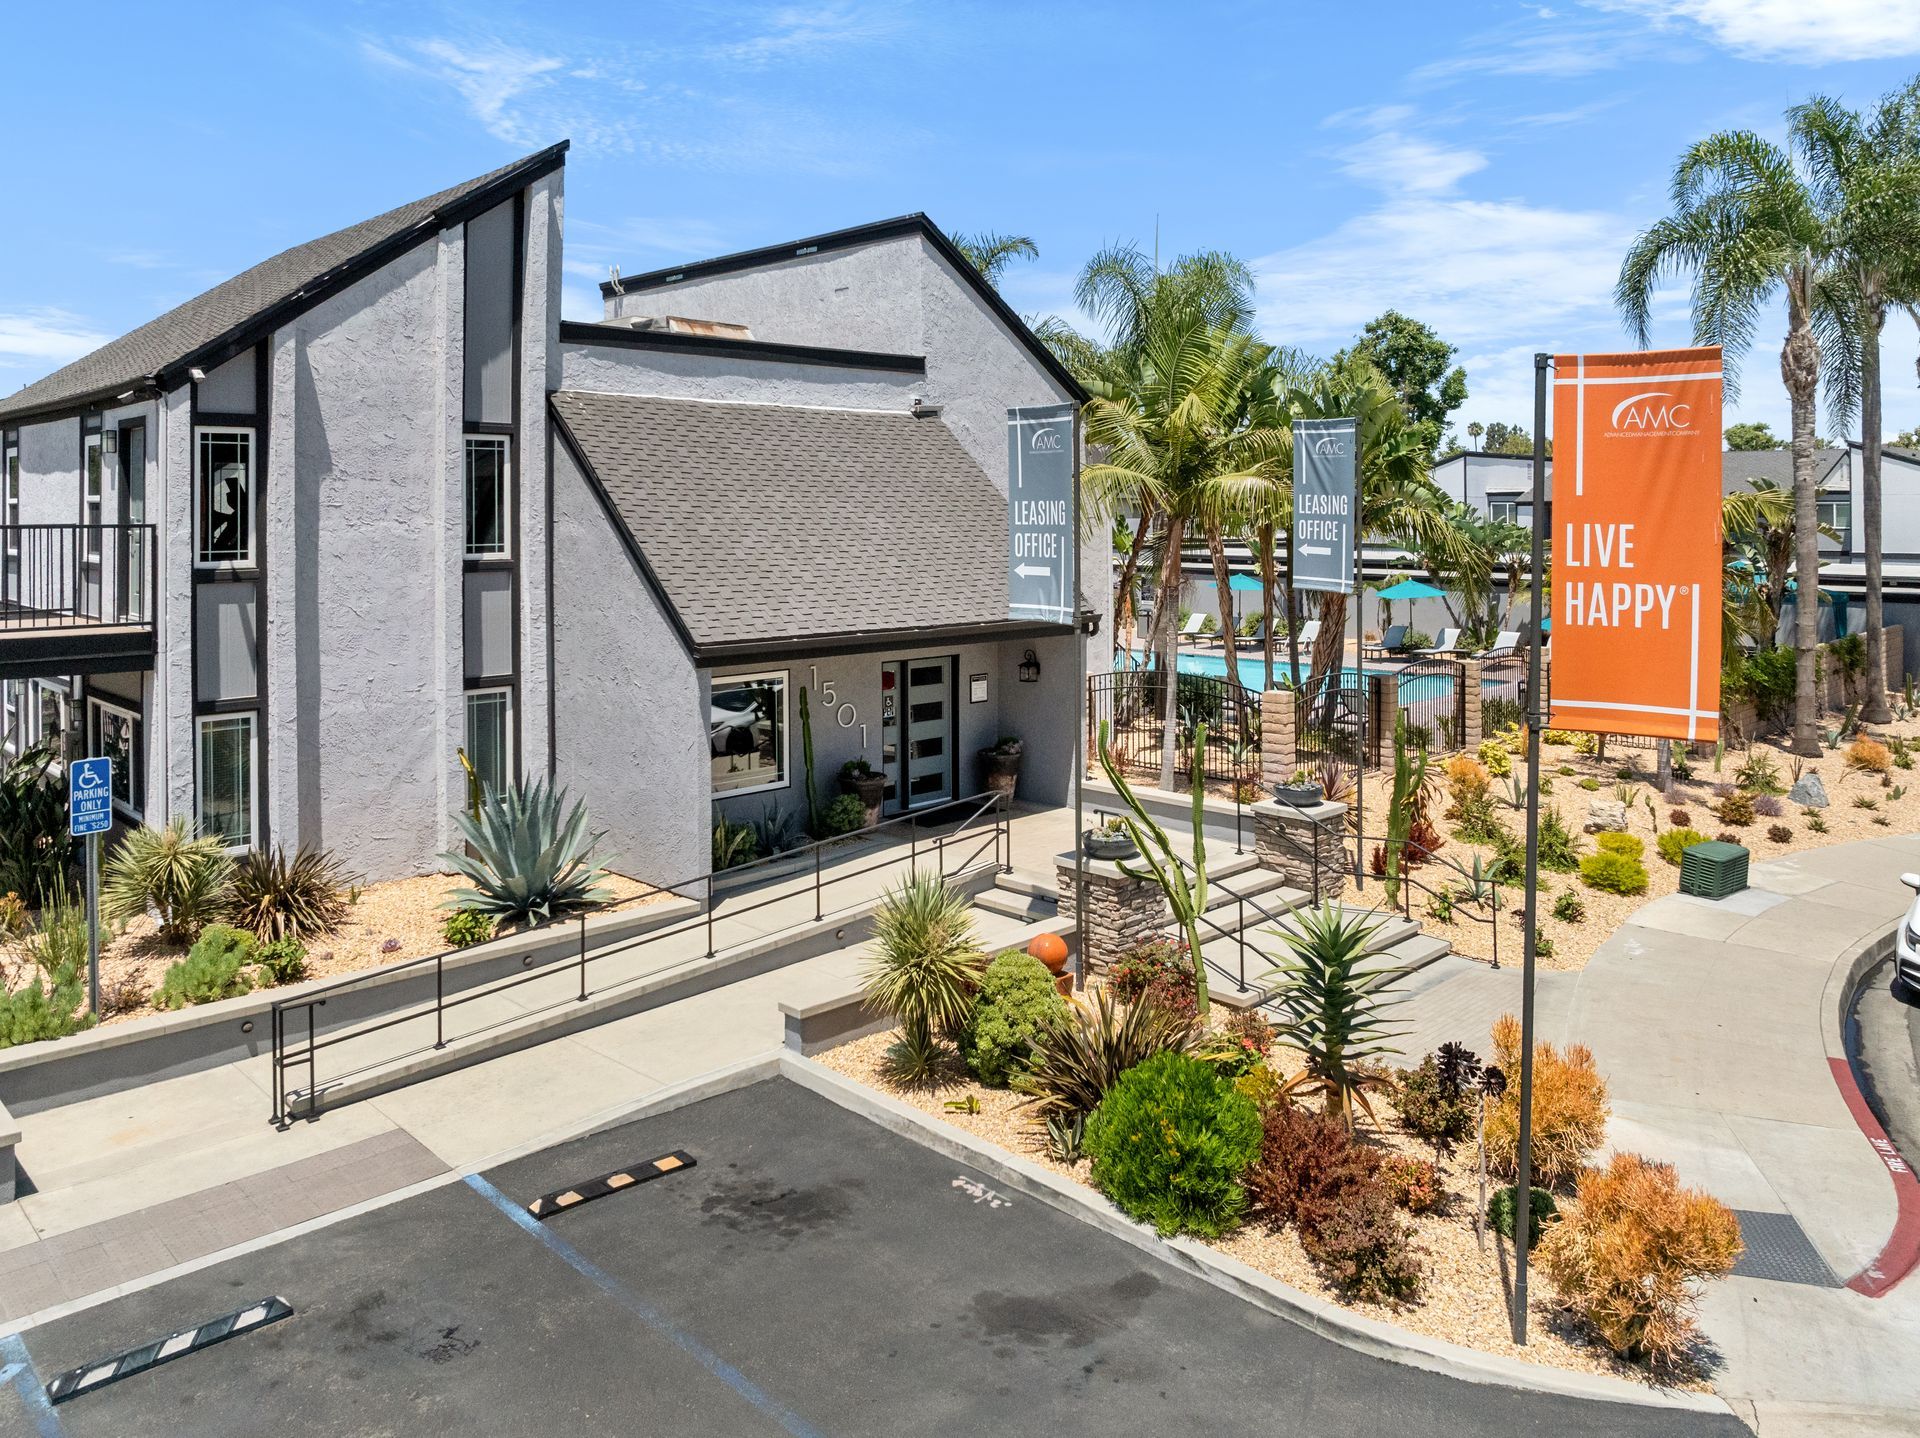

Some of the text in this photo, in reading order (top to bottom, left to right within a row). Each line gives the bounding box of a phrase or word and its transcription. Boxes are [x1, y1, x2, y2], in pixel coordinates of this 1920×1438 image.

[1623, 404, 1690, 430] AMC
[1036, 434, 1062, 450] AMC
[1320, 442, 1345, 455] AMC
[1015, 500, 1066, 526] LEASING
[1299, 494, 1348, 516] LEASING
[1298, 519, 1339, 541] OFFICE
[1015, 532, 1057, 558] OFFICE
[1566, 523, 1635, 568] LIVE
[810, 665, 867, 748] 1501
[73, 786, 109, 802] PARKING
[80, 799, 102, 812] ONLY
[78, 812, 105, 824] MINIMUM
[74, 824, 88, 833] FINE
[1883, 1156, 1909, 1173] FIRE
